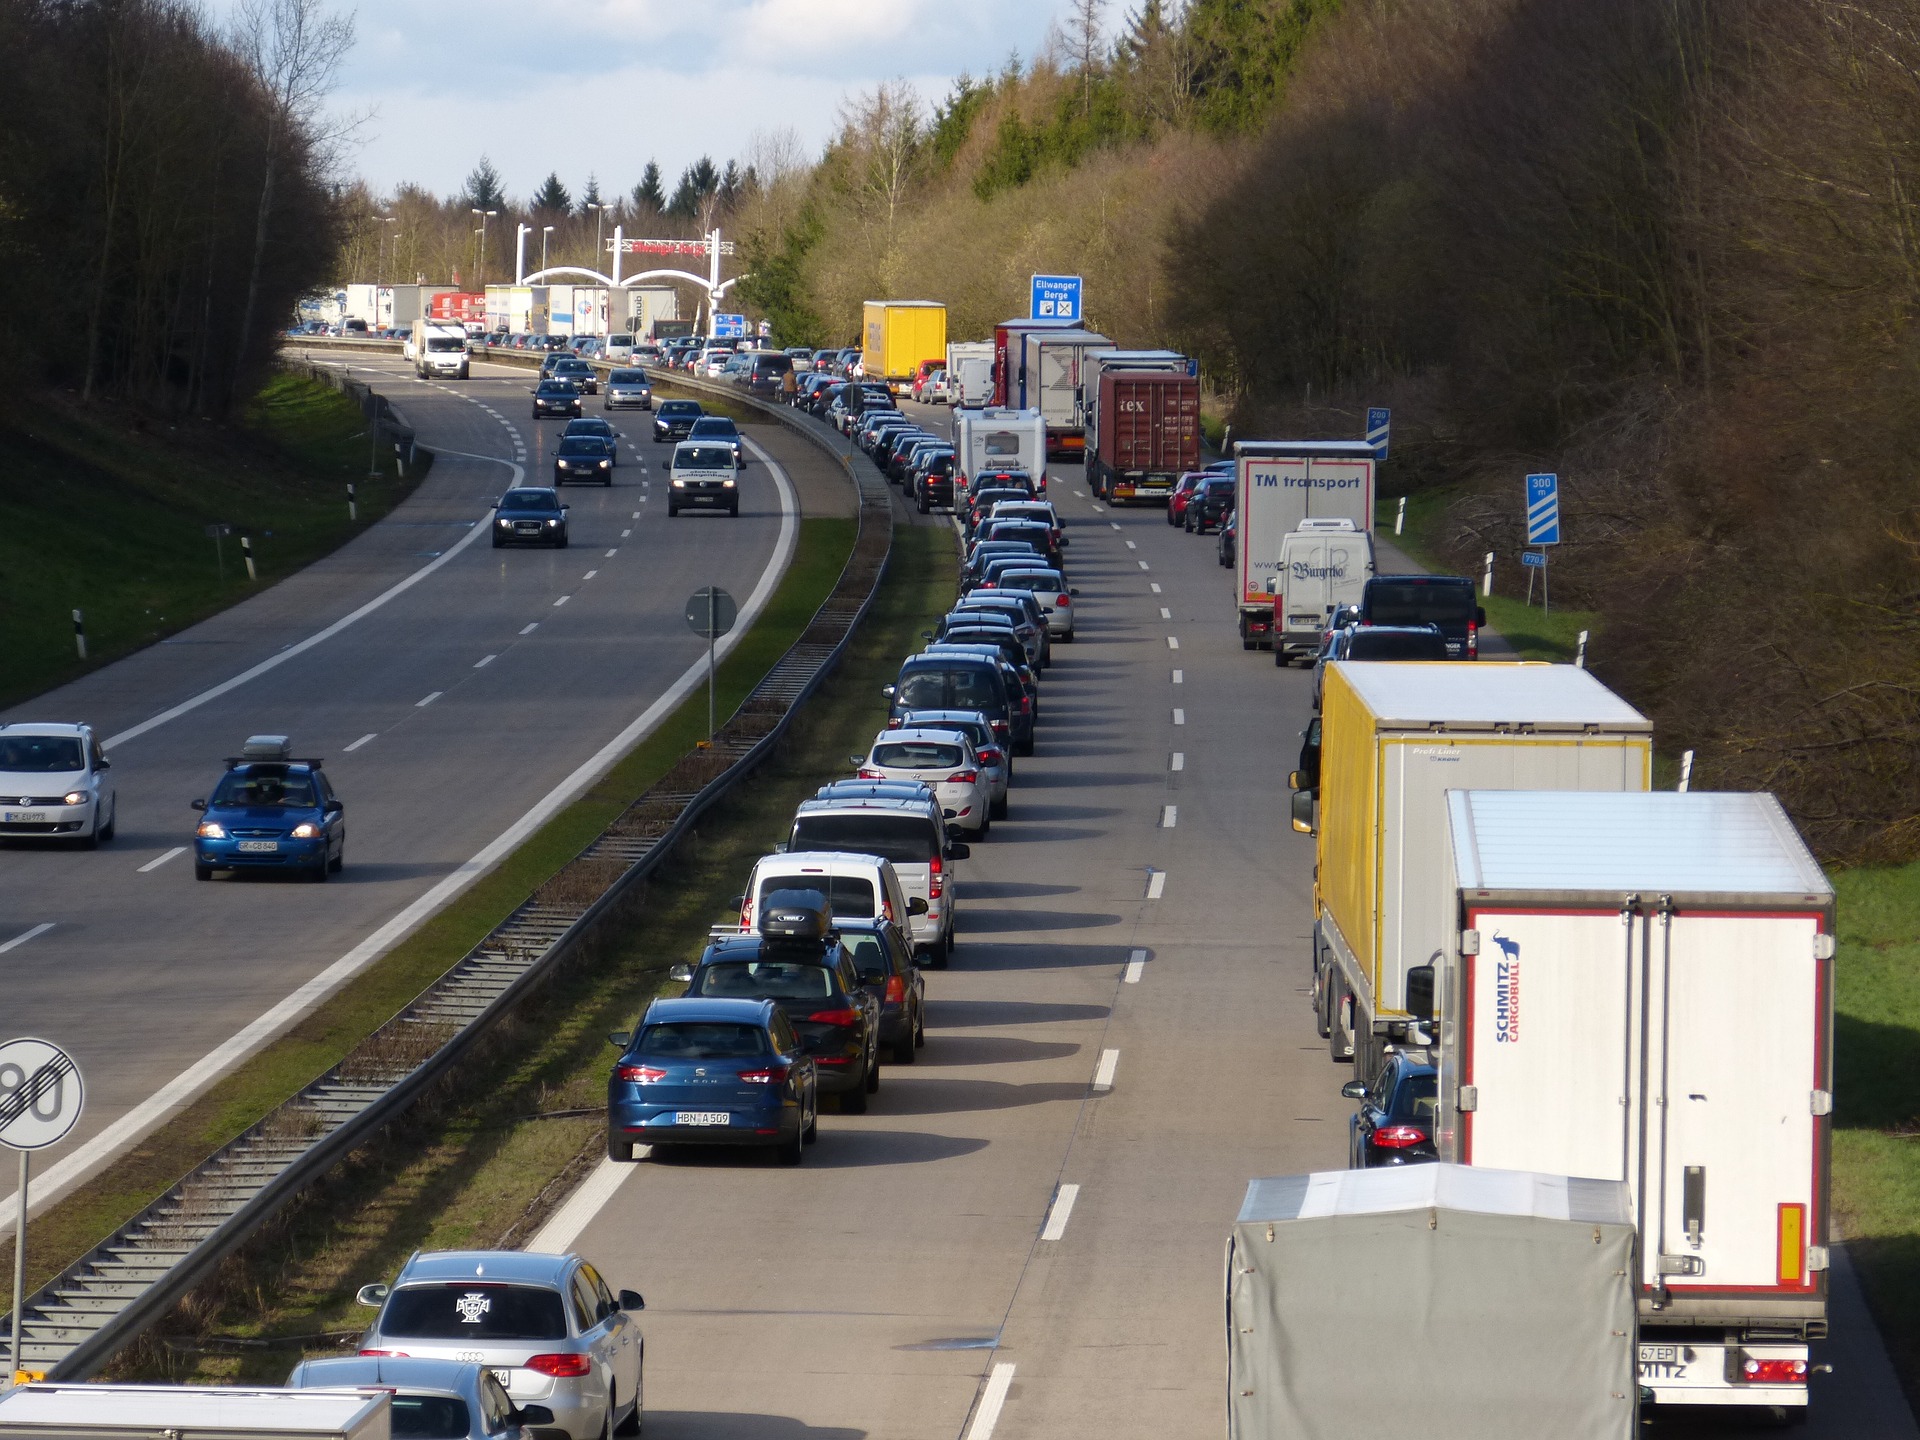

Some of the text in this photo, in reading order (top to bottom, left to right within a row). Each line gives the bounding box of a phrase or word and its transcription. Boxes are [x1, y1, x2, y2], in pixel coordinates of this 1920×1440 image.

[1036, 280, 1077, 291] Ellwanger
[1044, 291, 1068, 300] Berge
[1120, 399, 1144, 412] tex
[1371, 411, 1386, 419] 200
[1255, 474, 1360, 491] TM transport
[1532, 478, 1551, 488] 300
[1412, 747, 1461, 755] Profi Liner
[1496, 962, 1509, 1043] SCHMITZ
[1510, 962, 1519, 1043] CARGOBULL
[0, 1062, 63, 1122] 80
[677, 1114, 728, 1123] HBN A 509
[1641, 1347, 1673, 1360] 67 EP
